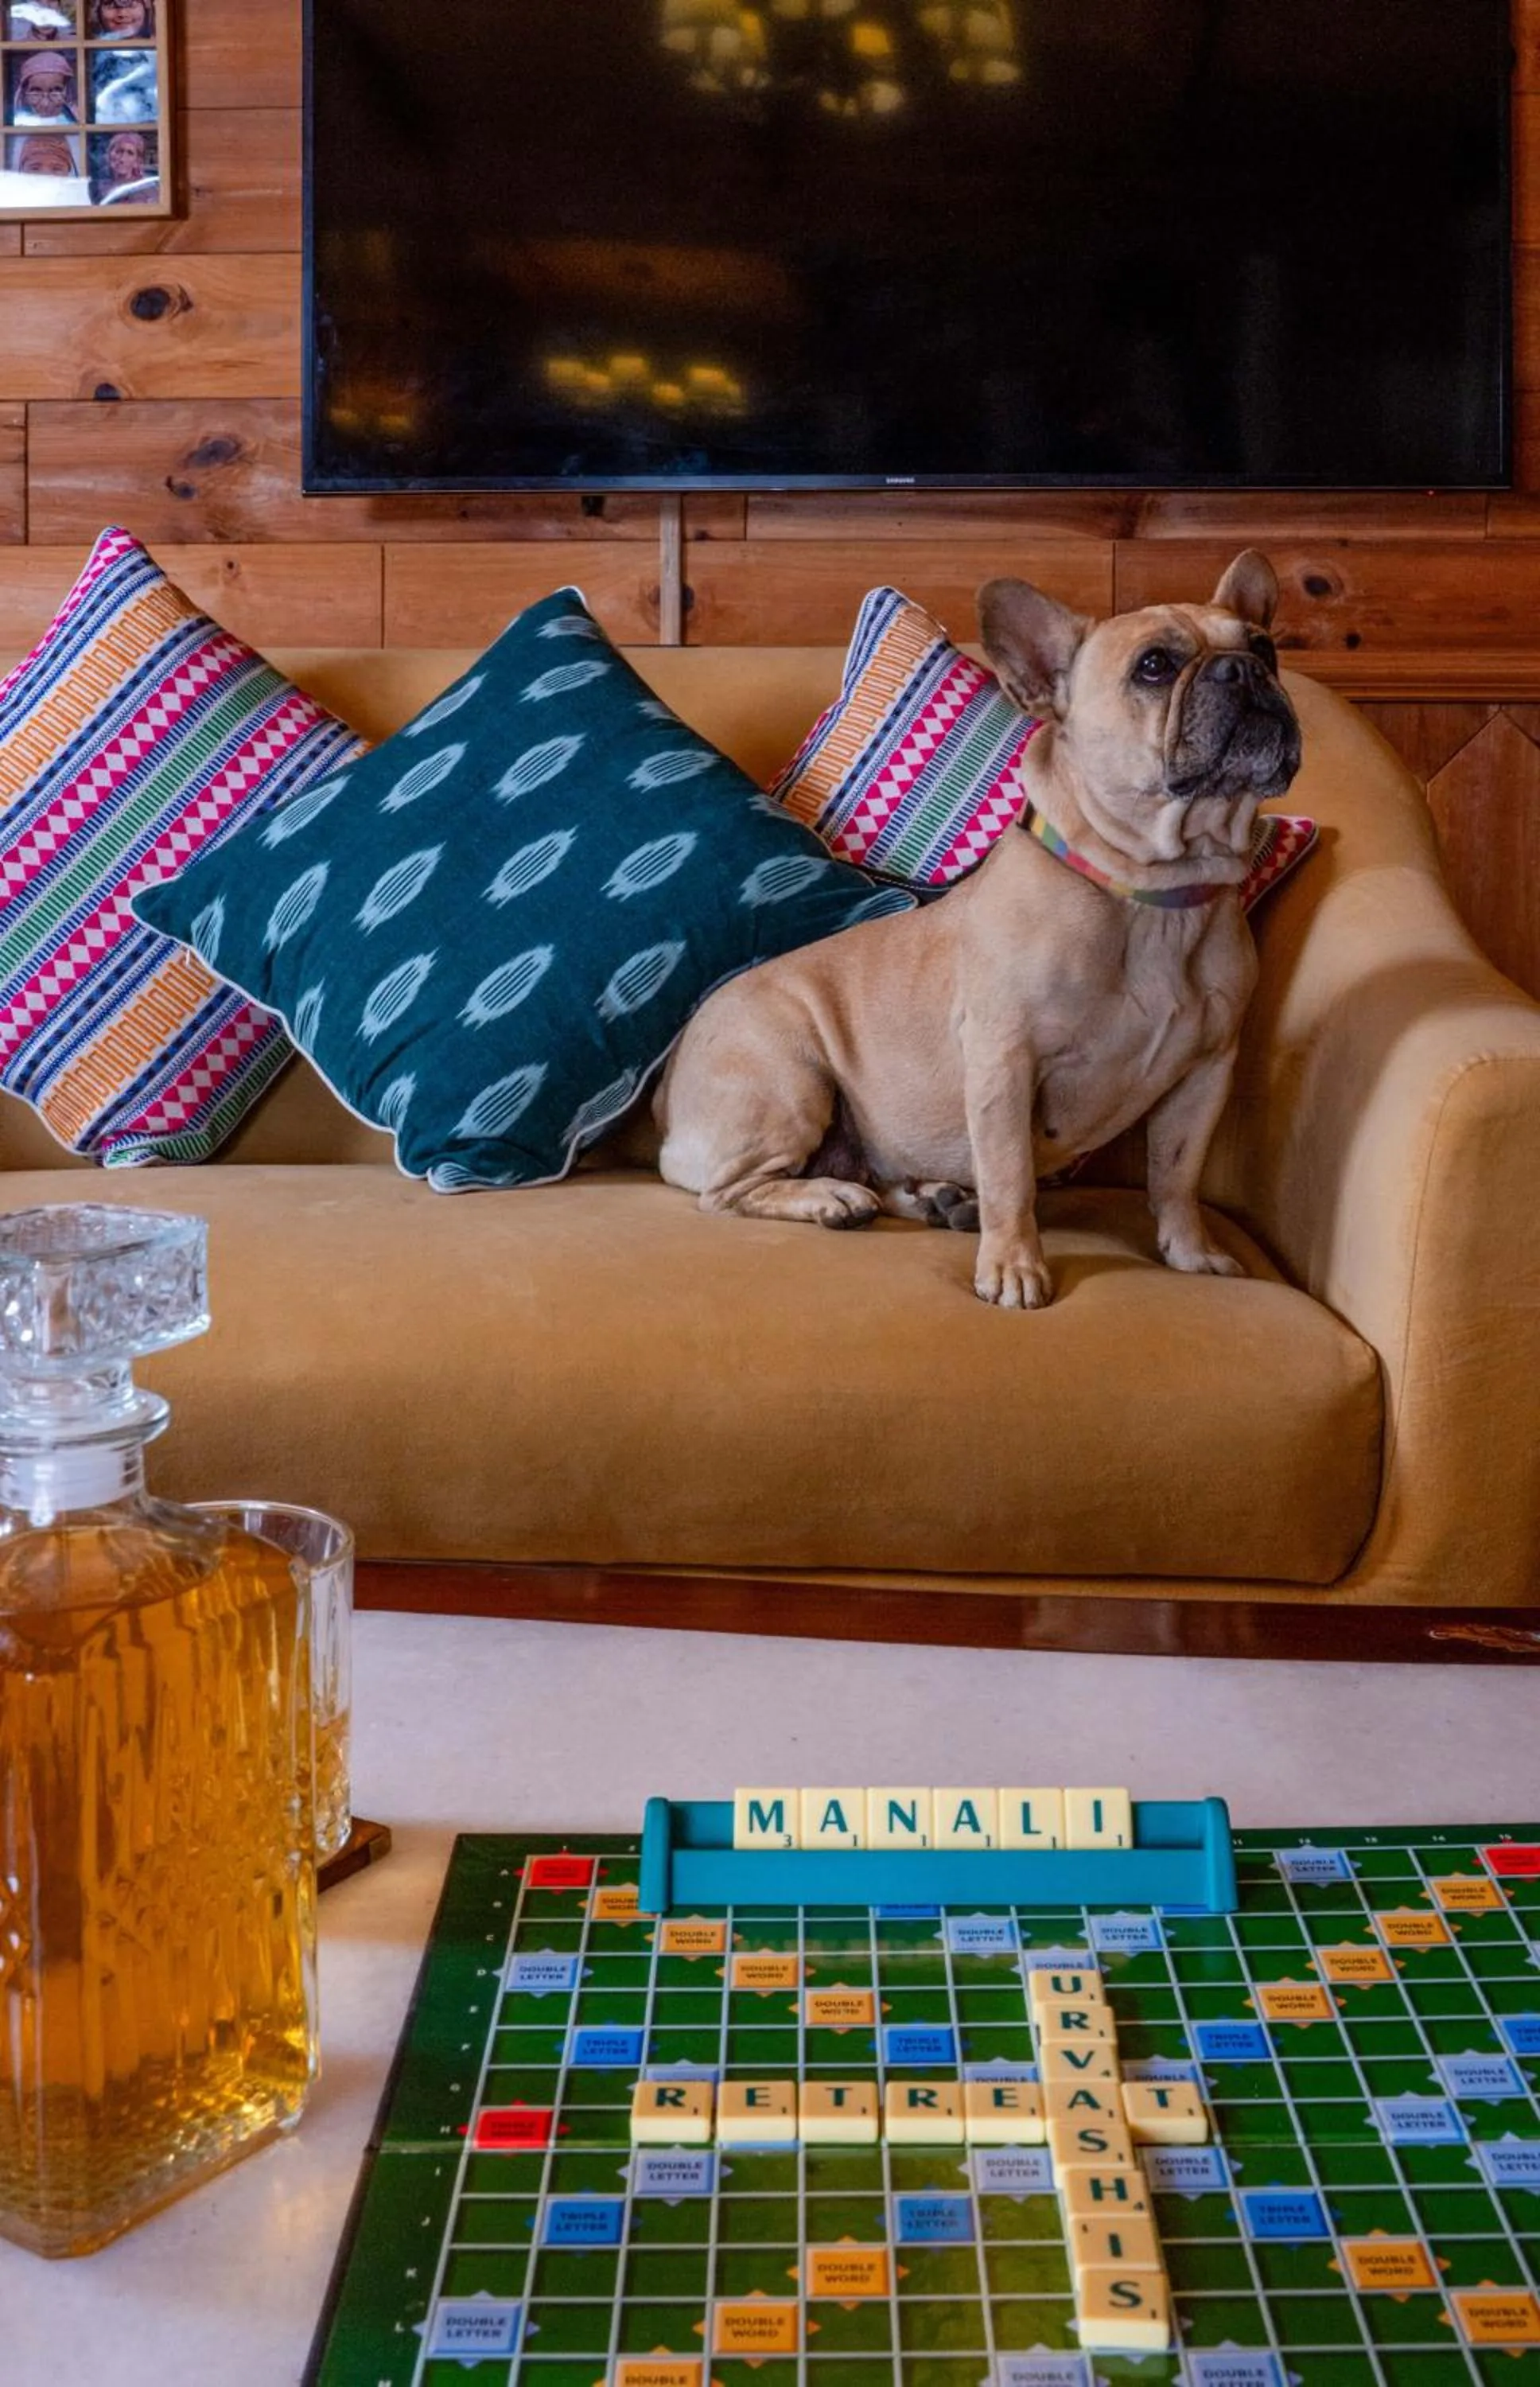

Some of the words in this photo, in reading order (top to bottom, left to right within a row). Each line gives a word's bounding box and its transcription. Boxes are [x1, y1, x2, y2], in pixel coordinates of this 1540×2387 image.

[749, 1799, 1102, 1833] MANALI
[784, 1834, 792, 1848] 3
[853, 1834, 858, 1847] 1
[921, 1834, 926, 1847] 1
[986, 1834, 990, 1847] 1
[1052, 1836, 1056, 1848] 1
[1118, 1834, 1122, 1846] 1
[655, 2087, 1174, 2109] RETREAT
[647, 2161, 702, 2170] DOUBLE
[1499, 2163, 1540, 2171] LETTE
[649, 2171, 699, 2180] LETTER
[1358, 2256, 1416, 2264] DOUBLE
[817, 2264, 874, 2272] DOUBLE
[825, 2274, 870, 2283] WORD
[1468, 2308, 1528, 2317] DOUBLE
[446, 2317, 506, 2327] DOUBLE
[725, 2317, 784, 2326] DOUBLE
[1480, 2319, 1526, 2328] WORD
[447, 2329, 501, 2338] LETTER
[732, 2329, 778, 2338] WORD
[1012, 2372, 1074, 2381] DOUBLE
[1204, 2369, 1266, 2378] DOUBLE
[625, 2376, 687, 2385] DOUBLE
